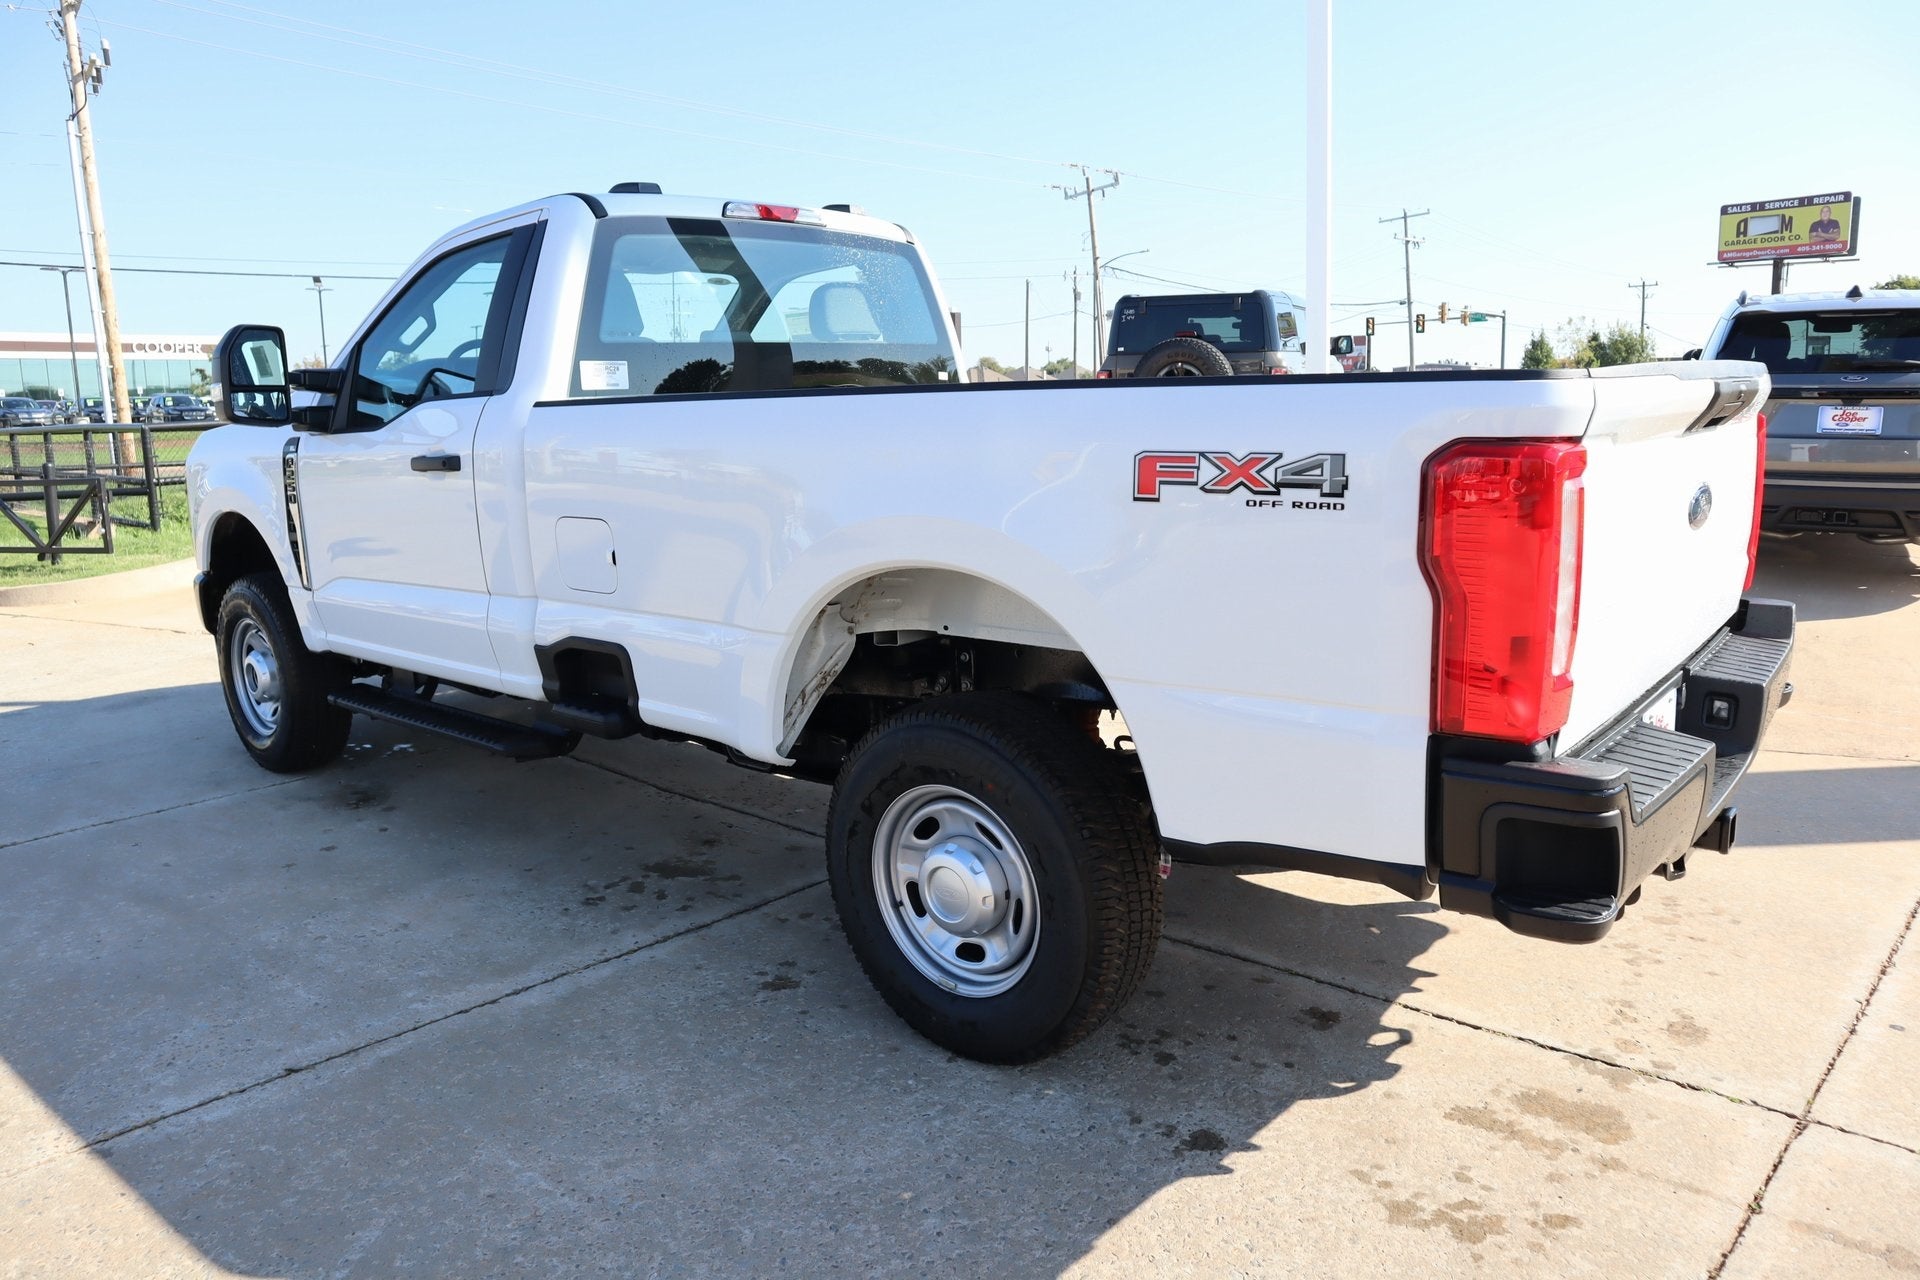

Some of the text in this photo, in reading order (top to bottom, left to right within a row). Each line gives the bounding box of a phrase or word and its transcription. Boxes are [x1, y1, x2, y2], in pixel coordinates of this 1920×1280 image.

[1727, 194, 1845, 214] SALES SERVICE REPAIR
[1724, 238, 1758, 247] GARAGE
[1760, 236, 1786, 244] DOOR
[132, 342, 203, 353] COOPER
[1831, 414, 1869, 423] Cooper
[1133, 450, 1348, 502] FX4
[1245, 499, 1345, 511] OFF ROAD
